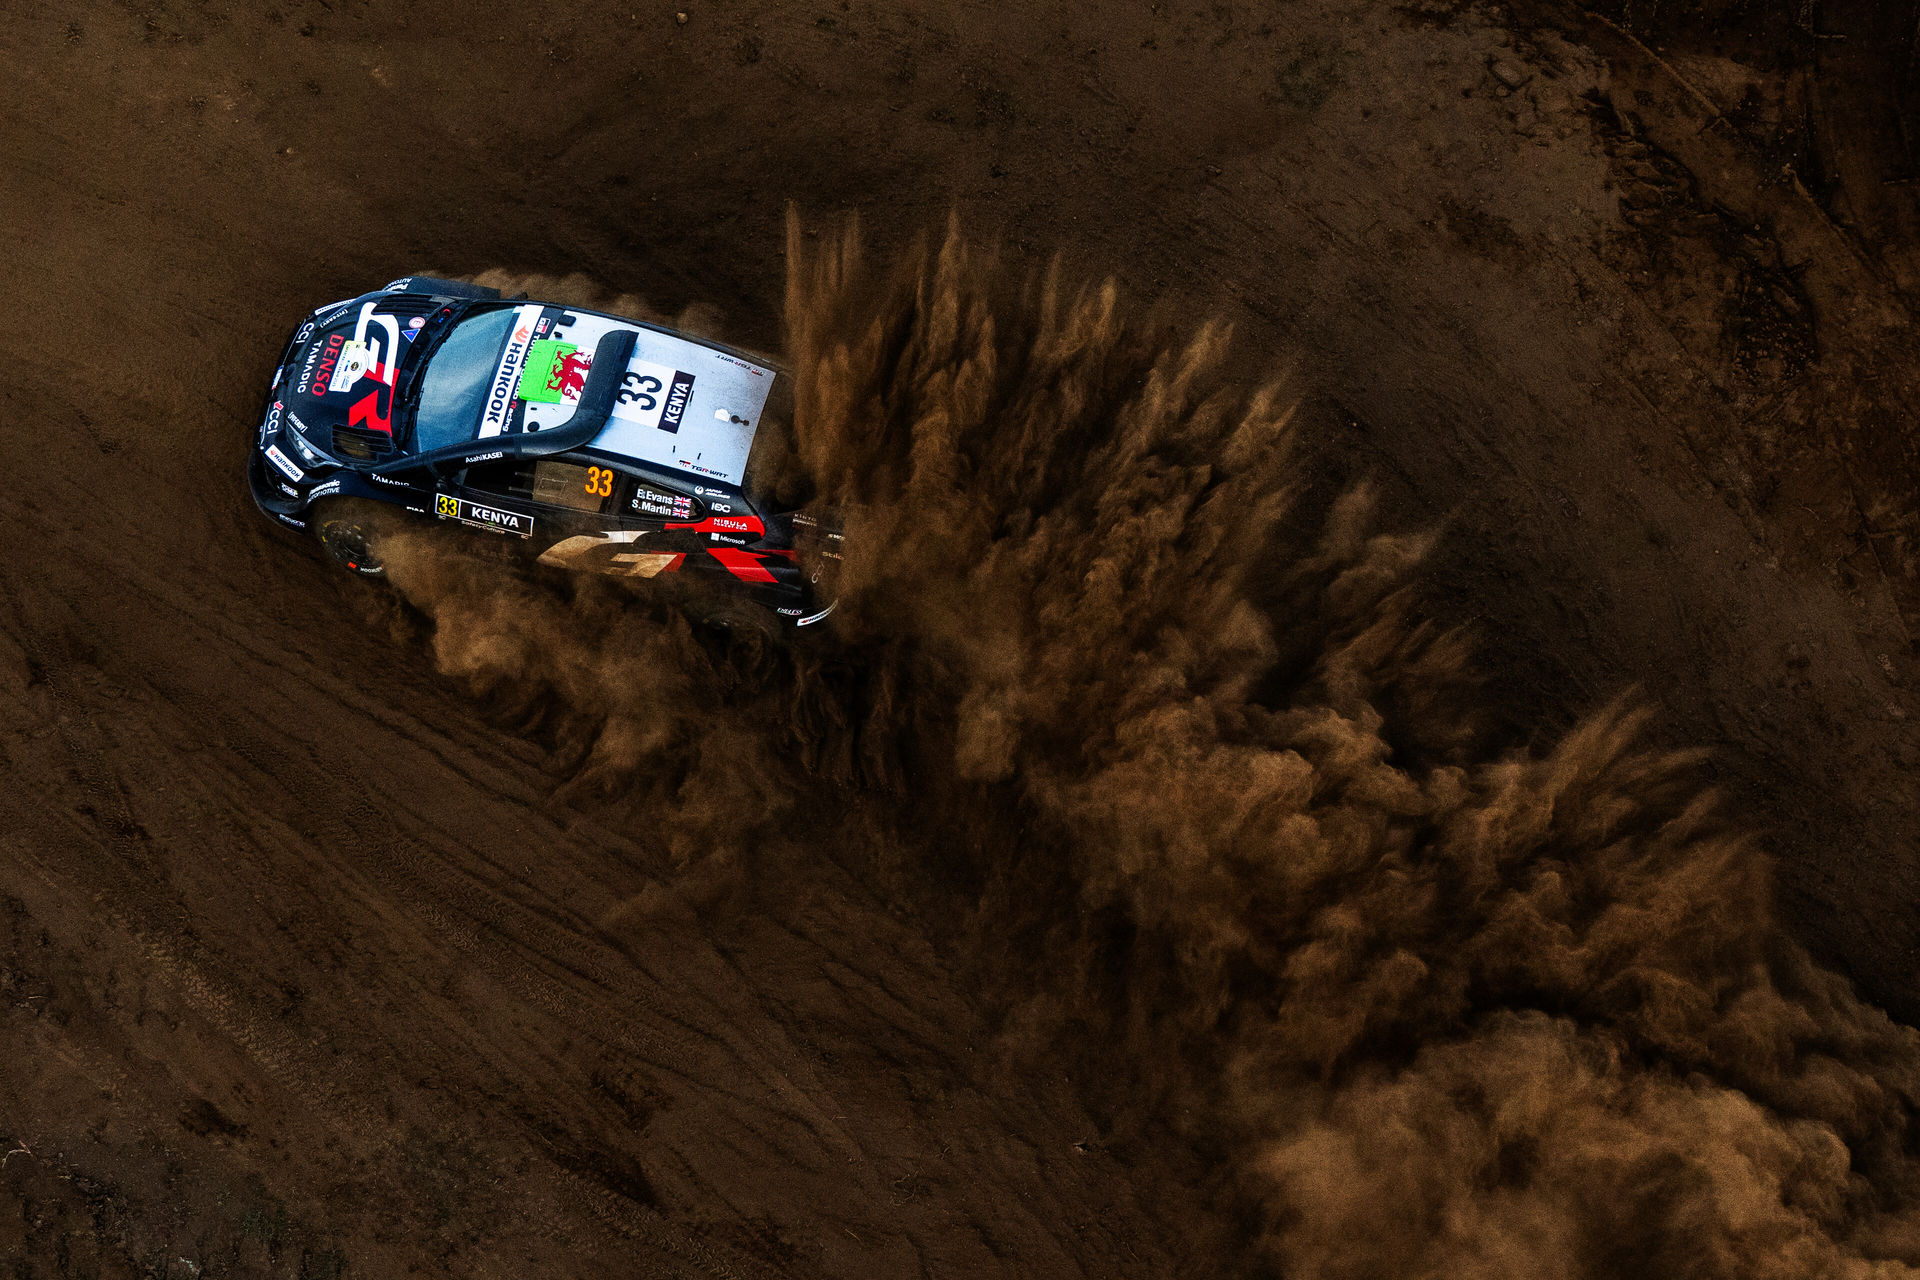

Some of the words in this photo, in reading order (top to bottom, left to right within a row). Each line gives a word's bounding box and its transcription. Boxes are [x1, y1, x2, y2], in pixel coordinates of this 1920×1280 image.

[296, 322, 315, 344] CCI
[297, 340, 323, 393] TAMADIC
[312, 334, 344, 397] DENSO
[616, 371, 662, 412] 33
[664, 382, 690, 424] KENYA
[267, 409, 280, 434] CCI
[585, 466, 614, 498] 33
[438, 496, 458, 516] 33
[471, 506, 519, 528] KENYA
[631, 498, 672, 516] S.Martin
[719, 535, 746, 545] Microsoft
